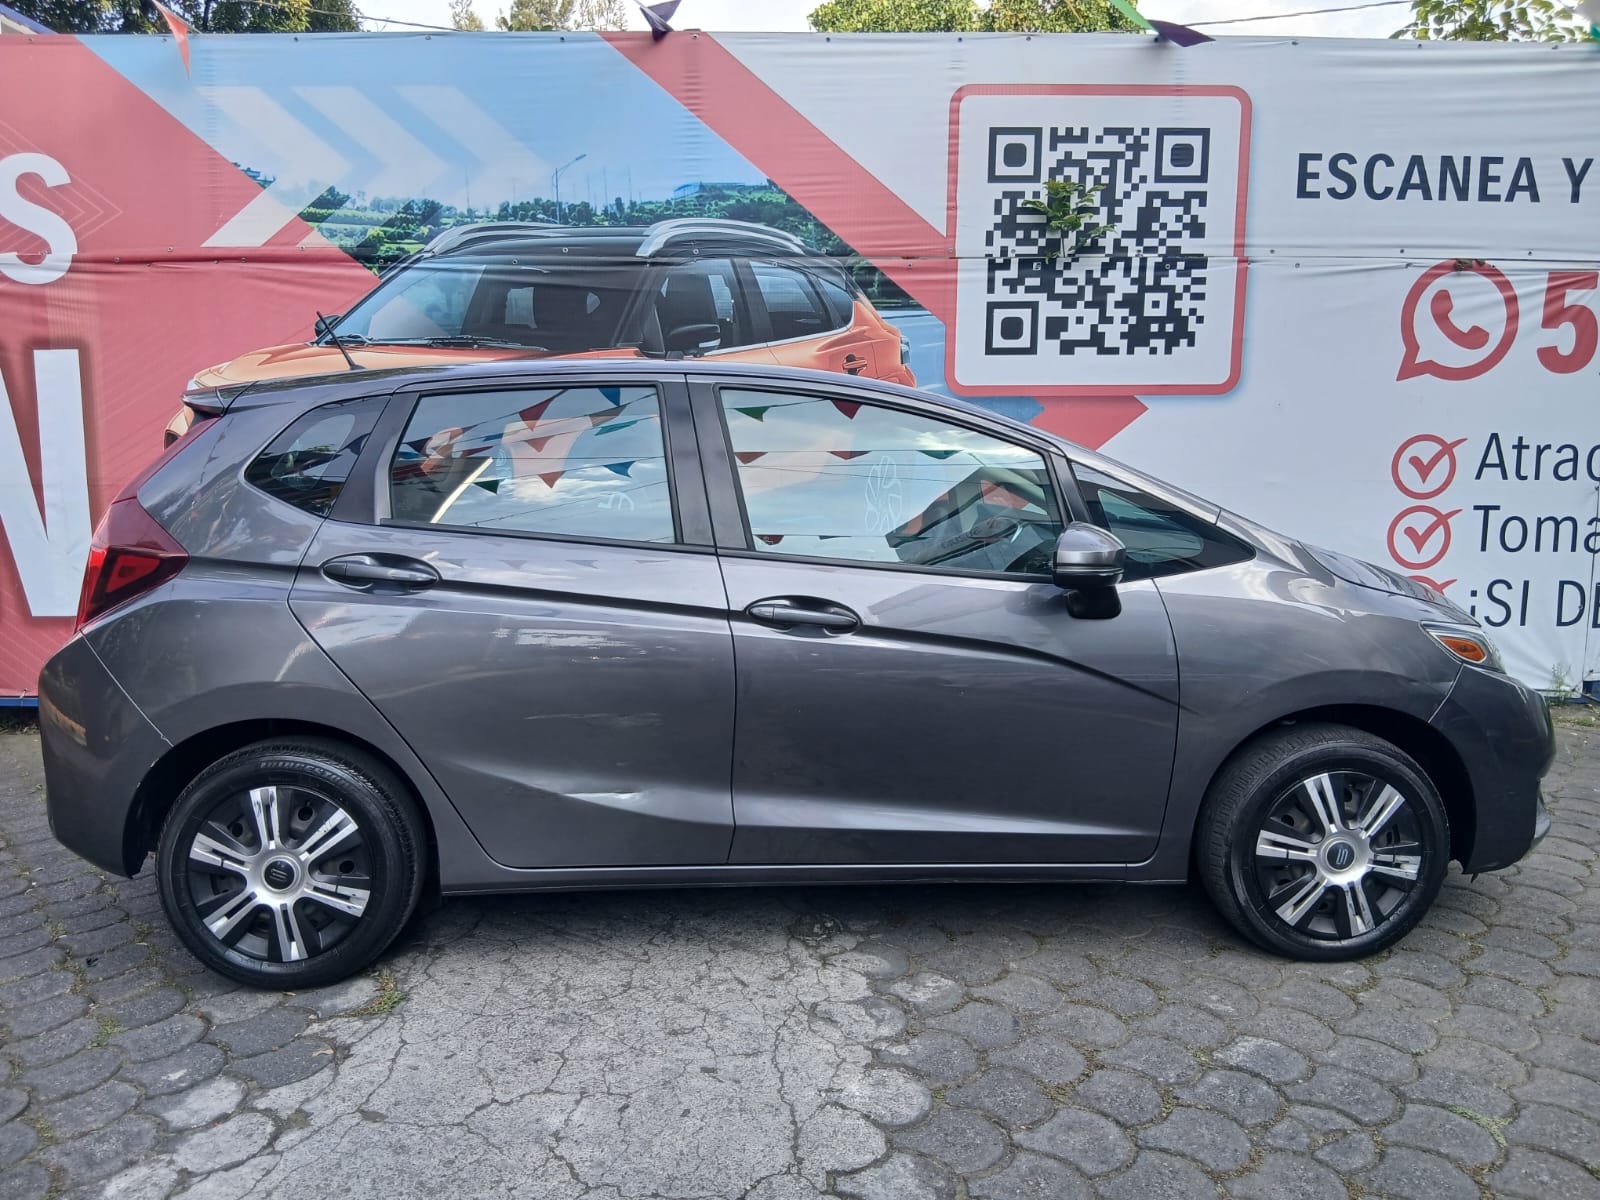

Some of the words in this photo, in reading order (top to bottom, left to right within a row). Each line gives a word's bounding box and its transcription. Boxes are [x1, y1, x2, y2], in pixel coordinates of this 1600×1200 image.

[1296, 152, 1541, 204] ESCANEA
[1562, 157, 1594, 204] Y
[1536, 271, 1600, 375] 5
